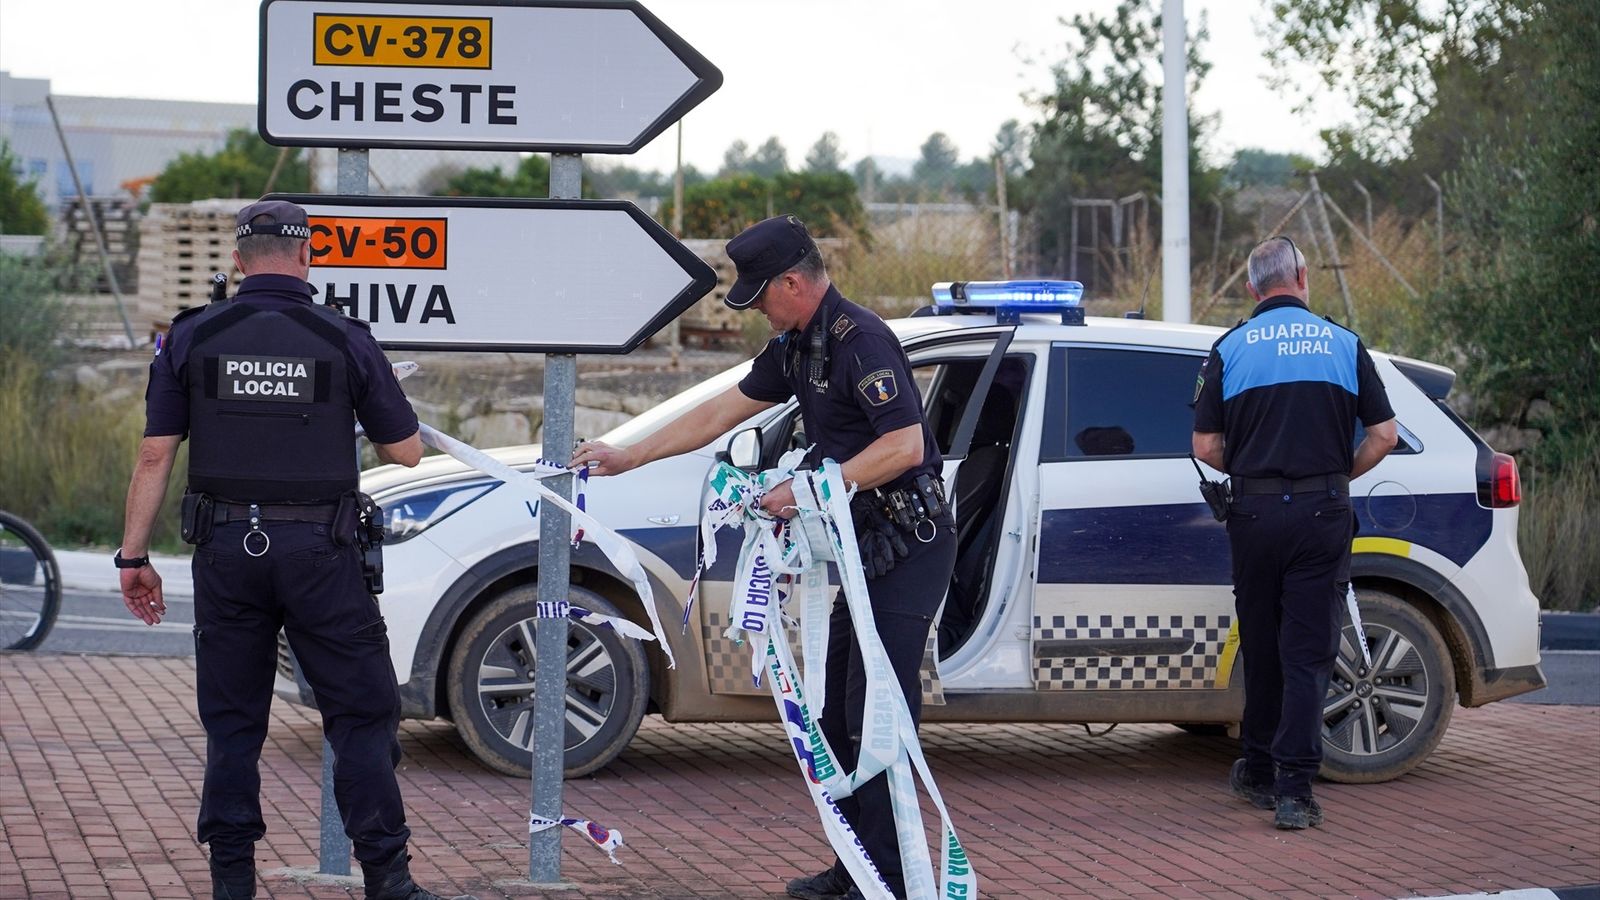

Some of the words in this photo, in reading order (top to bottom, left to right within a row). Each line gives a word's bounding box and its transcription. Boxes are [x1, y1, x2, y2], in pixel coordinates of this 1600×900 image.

[324, 23, 483, 59] CV-378
[286, 79, 518, 125] CHESTE
[310, 225, 438, 259] CV-50
[308, 282, 456, 324] HIVA
[1246, 323, 1334, 344] GUARDA
[1278, 340, 1333, 356] RURAL
[226, 360, 308, 378] POLICIA
[233, 380, 300, 396] LOCAL
